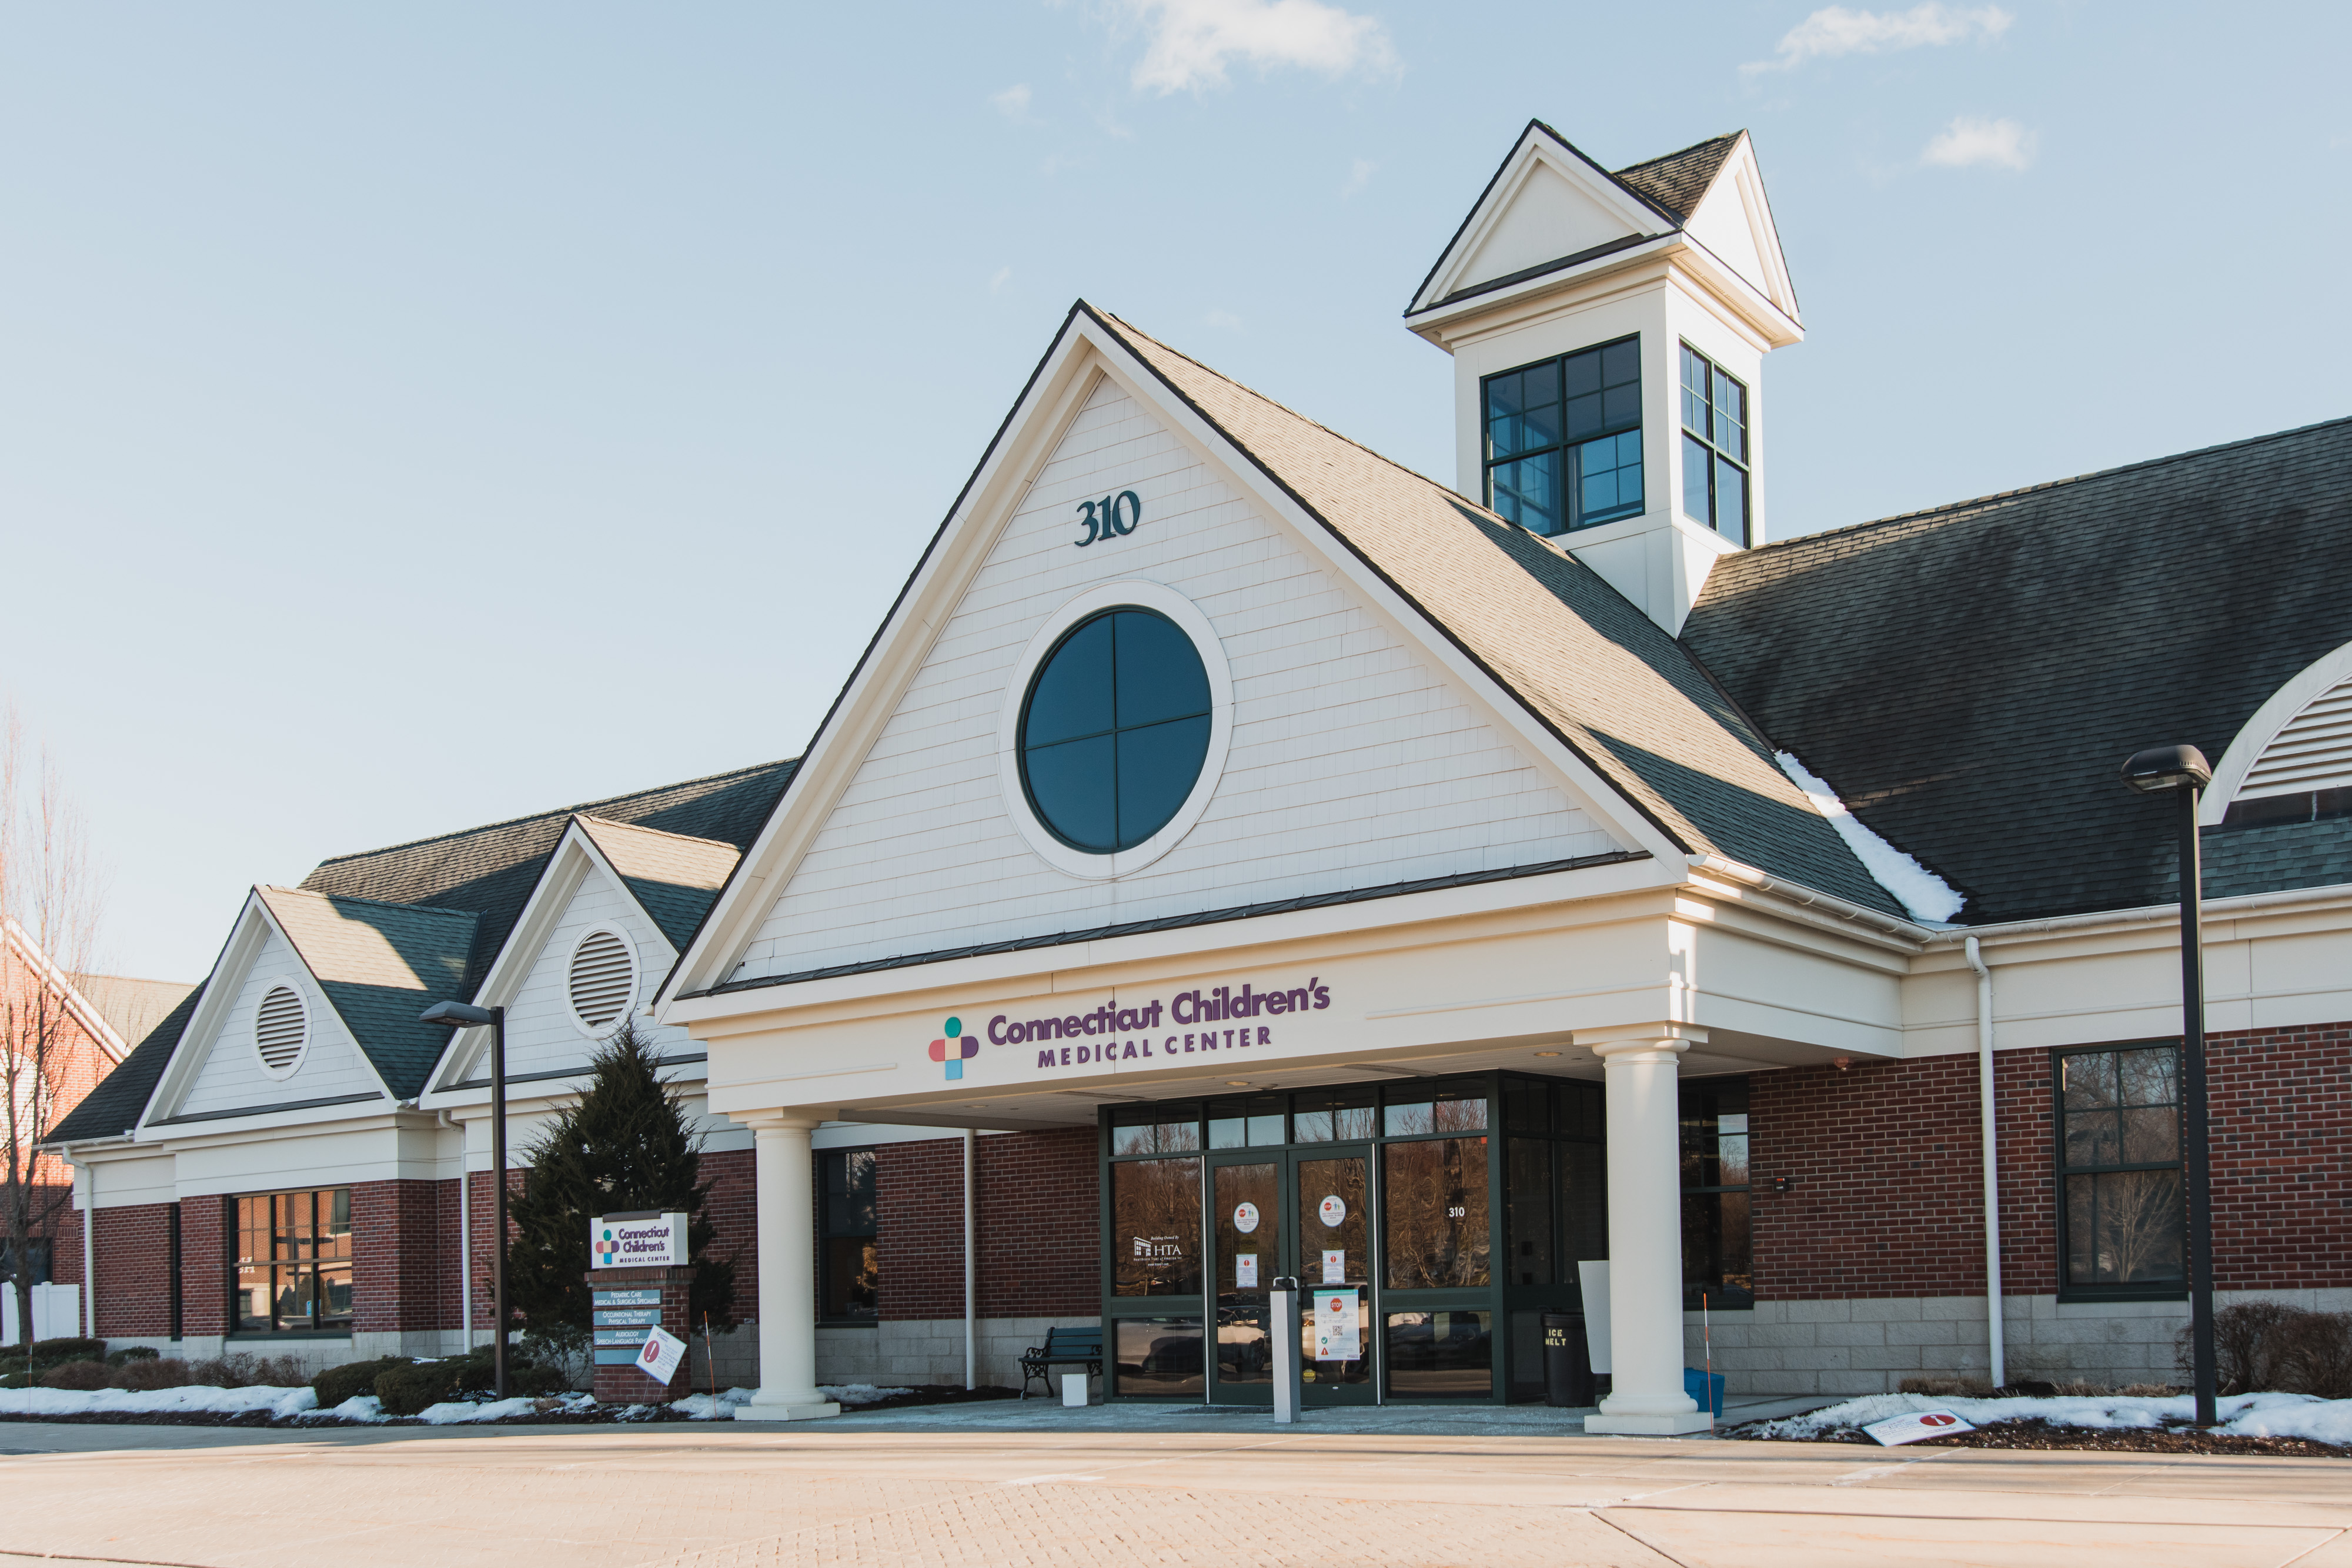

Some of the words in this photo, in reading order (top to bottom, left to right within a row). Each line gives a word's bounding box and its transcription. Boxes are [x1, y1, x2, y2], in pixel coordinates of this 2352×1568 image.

[1074, 490, 1140, 547] 310
[988, 999, 1162, 1045] Connecticut
[1171, 977, 1330, 1025] Children's
[1038, 1039, 1152, 1068] MEDICAL
[1165, 1026, 1271, 1055] CENTER
[1449, 1206, 1465, 1218] 310
[619, 1226, 670, 1239] Connecticut
[623, 1240, 665, 1253] Children's
[1154, 1245, 1182, 1256] HTA
[1545, 1338, 1566, 1346] MELT
